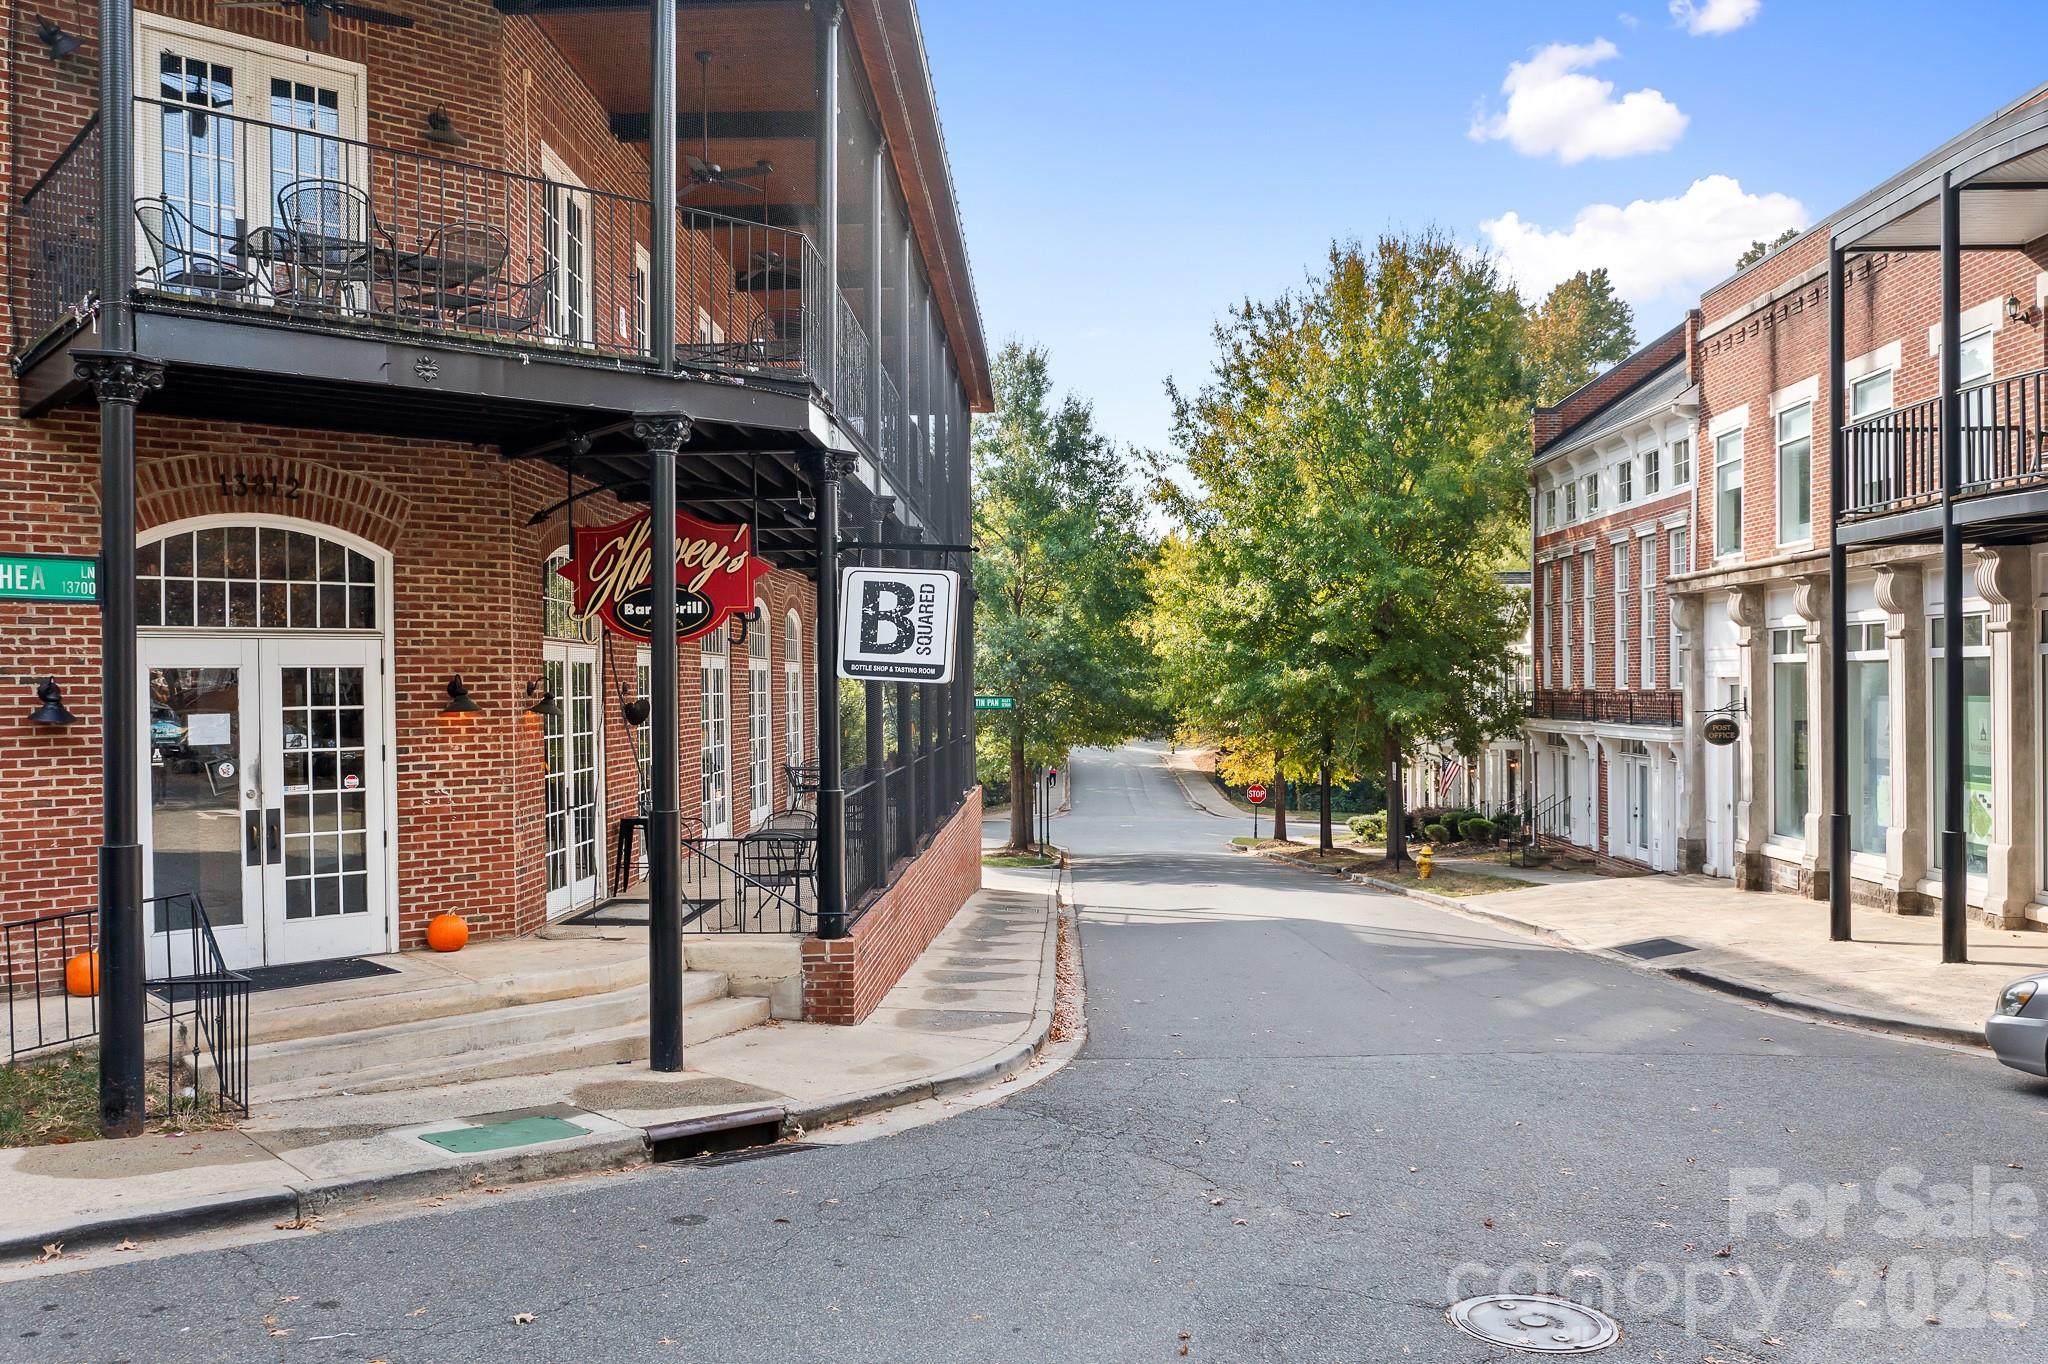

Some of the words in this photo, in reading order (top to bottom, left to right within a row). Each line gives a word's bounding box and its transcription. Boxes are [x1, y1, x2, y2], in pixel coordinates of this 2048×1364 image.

[219, 474, 299, 499] 13812
[80, 566, 96, 579] LN
[568, 515, 748, 645] Havey's
[61, 581, 96, 595] 13700
[624, 603, 652, 615] Bar
[859, 580, 916, 655] B
[916, 583, 936, 656] SQUARED
[873, 664, 888, 672] SHOP
[895, 666, 918, 674] TASTING
[1248, 790, 1265, 798] STOP
